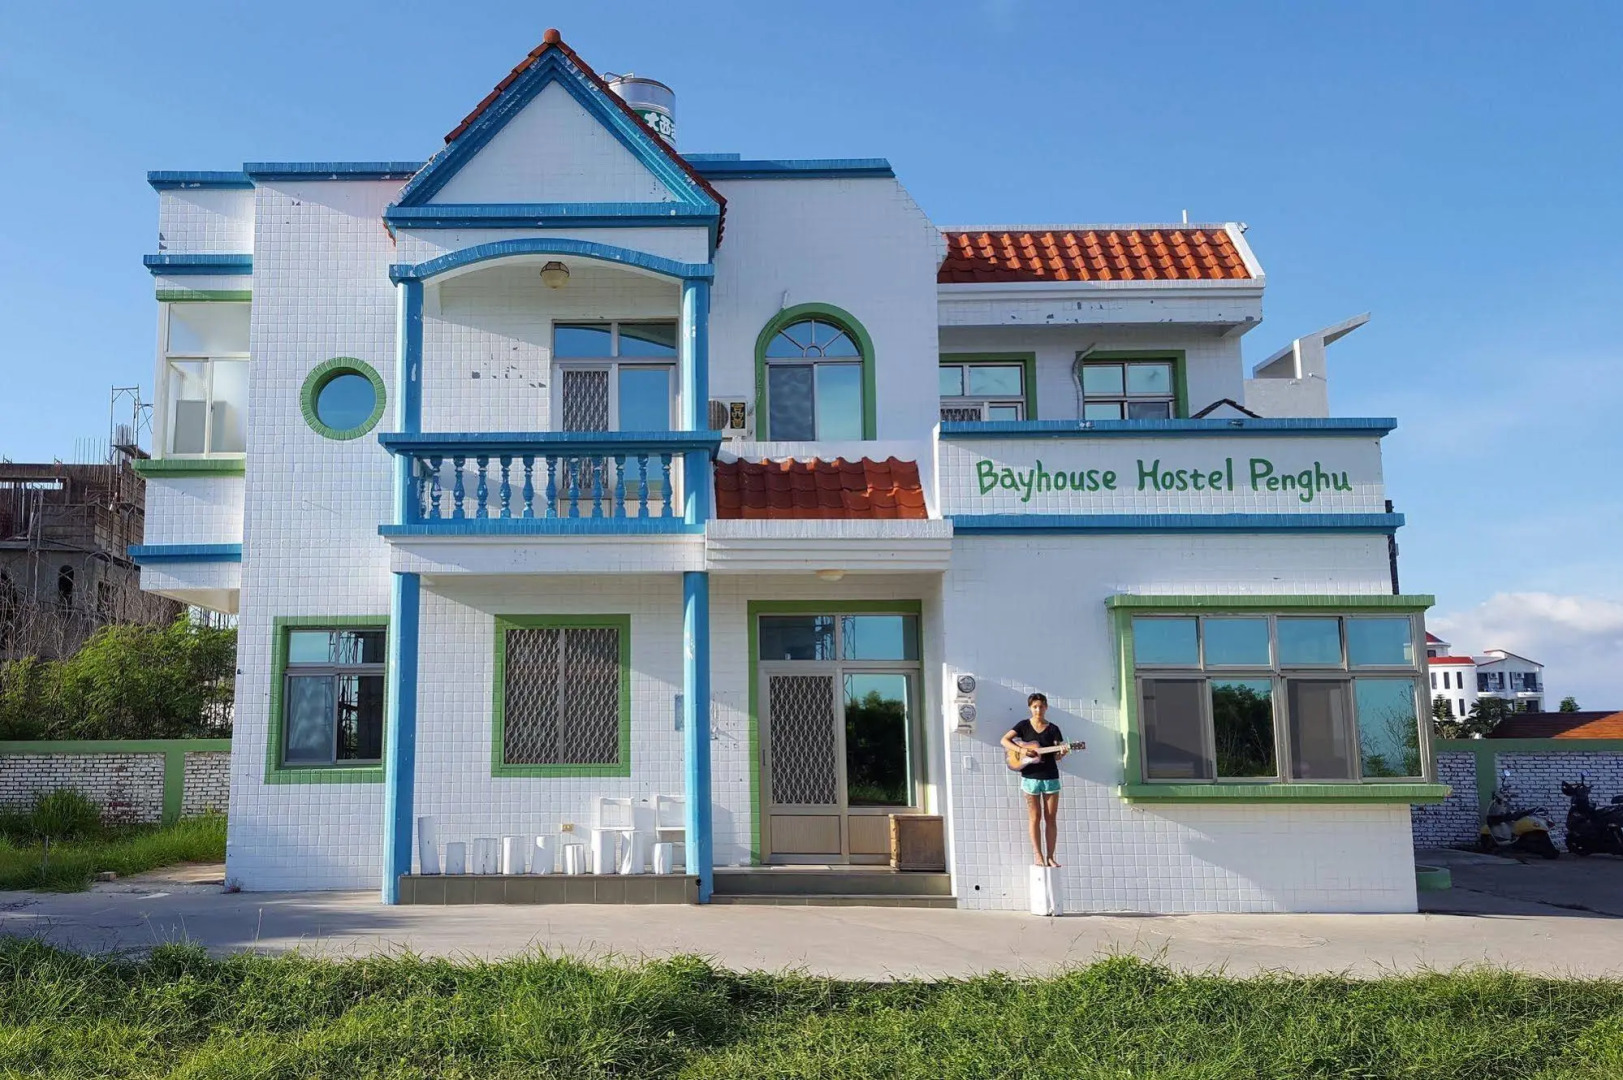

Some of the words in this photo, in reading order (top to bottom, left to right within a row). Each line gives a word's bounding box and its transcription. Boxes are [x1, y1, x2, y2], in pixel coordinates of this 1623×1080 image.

[976, 459, 1117, 502] Bayhouse
[1137, 457, 1233, 491] Hostel
[1250, 458, 1353, 502] Penghu
